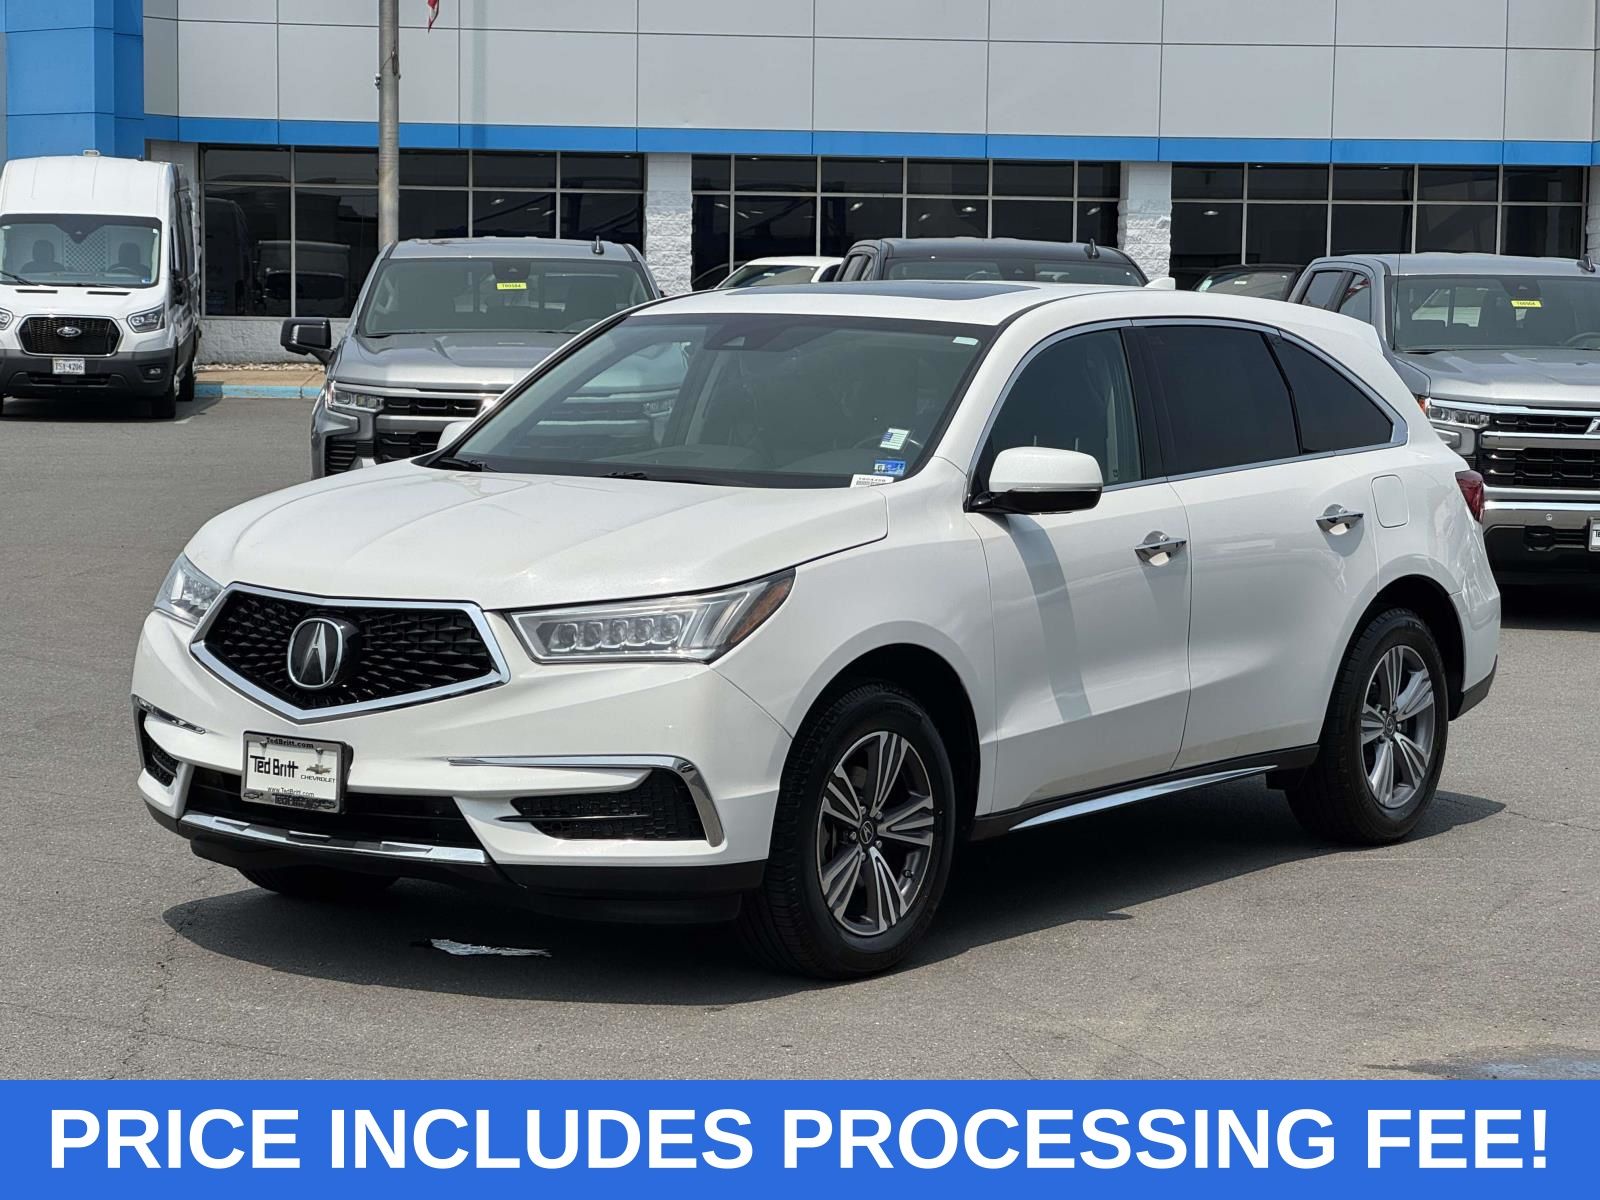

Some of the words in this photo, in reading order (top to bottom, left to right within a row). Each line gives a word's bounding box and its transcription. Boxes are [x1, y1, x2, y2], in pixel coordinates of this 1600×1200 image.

[250, 754, 271, 774] Ted
[273, 758, 298, 778] Britt
[301, 774, 336, 783] CHEVROLET
